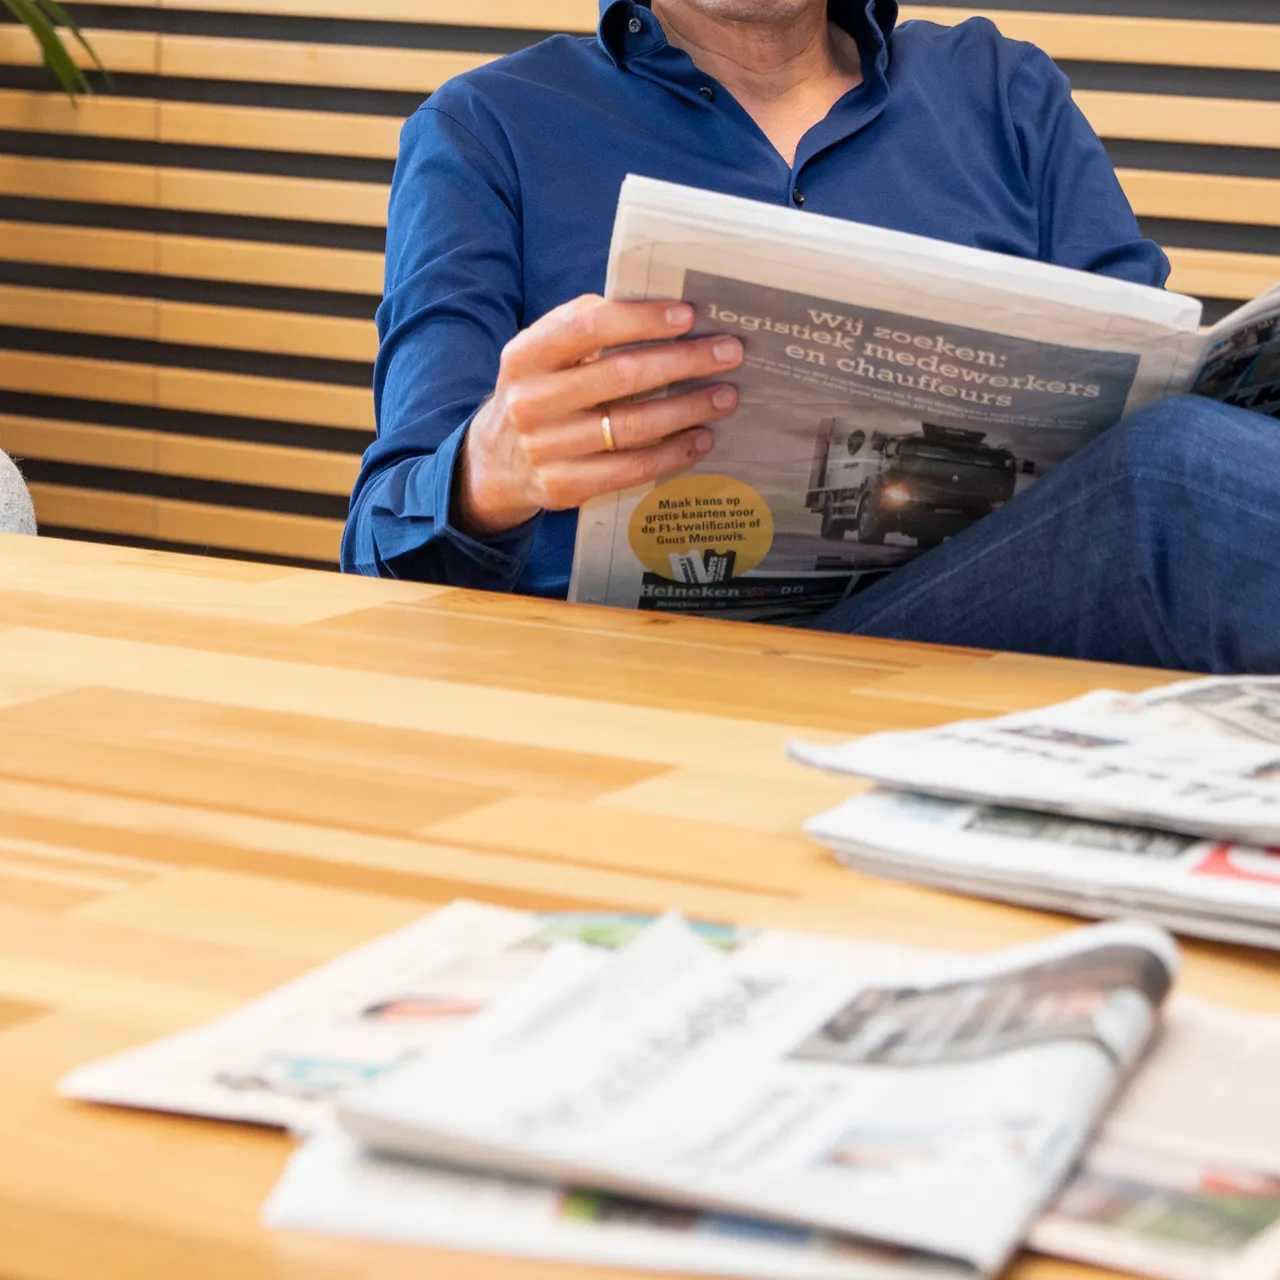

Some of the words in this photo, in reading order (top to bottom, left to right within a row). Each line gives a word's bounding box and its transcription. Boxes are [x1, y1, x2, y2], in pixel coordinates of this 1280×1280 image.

[806, 307, 864, 337] Wij
[874, 323, 1008, 369] zoeken:
[706, 303, 855, 353] logistiek
[862, 341, 1102, 399] medewerkers
[785, 344, 827, 367] en
[836, 354, 1014, 407] chauffeurs
[658, 499, 692, 510] Maak
[695, 497, 723, 507] kans
[726, 497, 741, 507] op
[645, 511, 679, 524] gratis
[681, 509, 726, 520] kaarten
[729, 508, 755, 518] voor
[641, 525, 656, 534] de
[658, 520, 746, 534] F1-kwalificatie
[748, 518, 761, 529] of
[656, 535, 686, 546] Guus
[688, 533, 747, 545] Meeuwis.
[640, 583, 740, 598] Heineken
